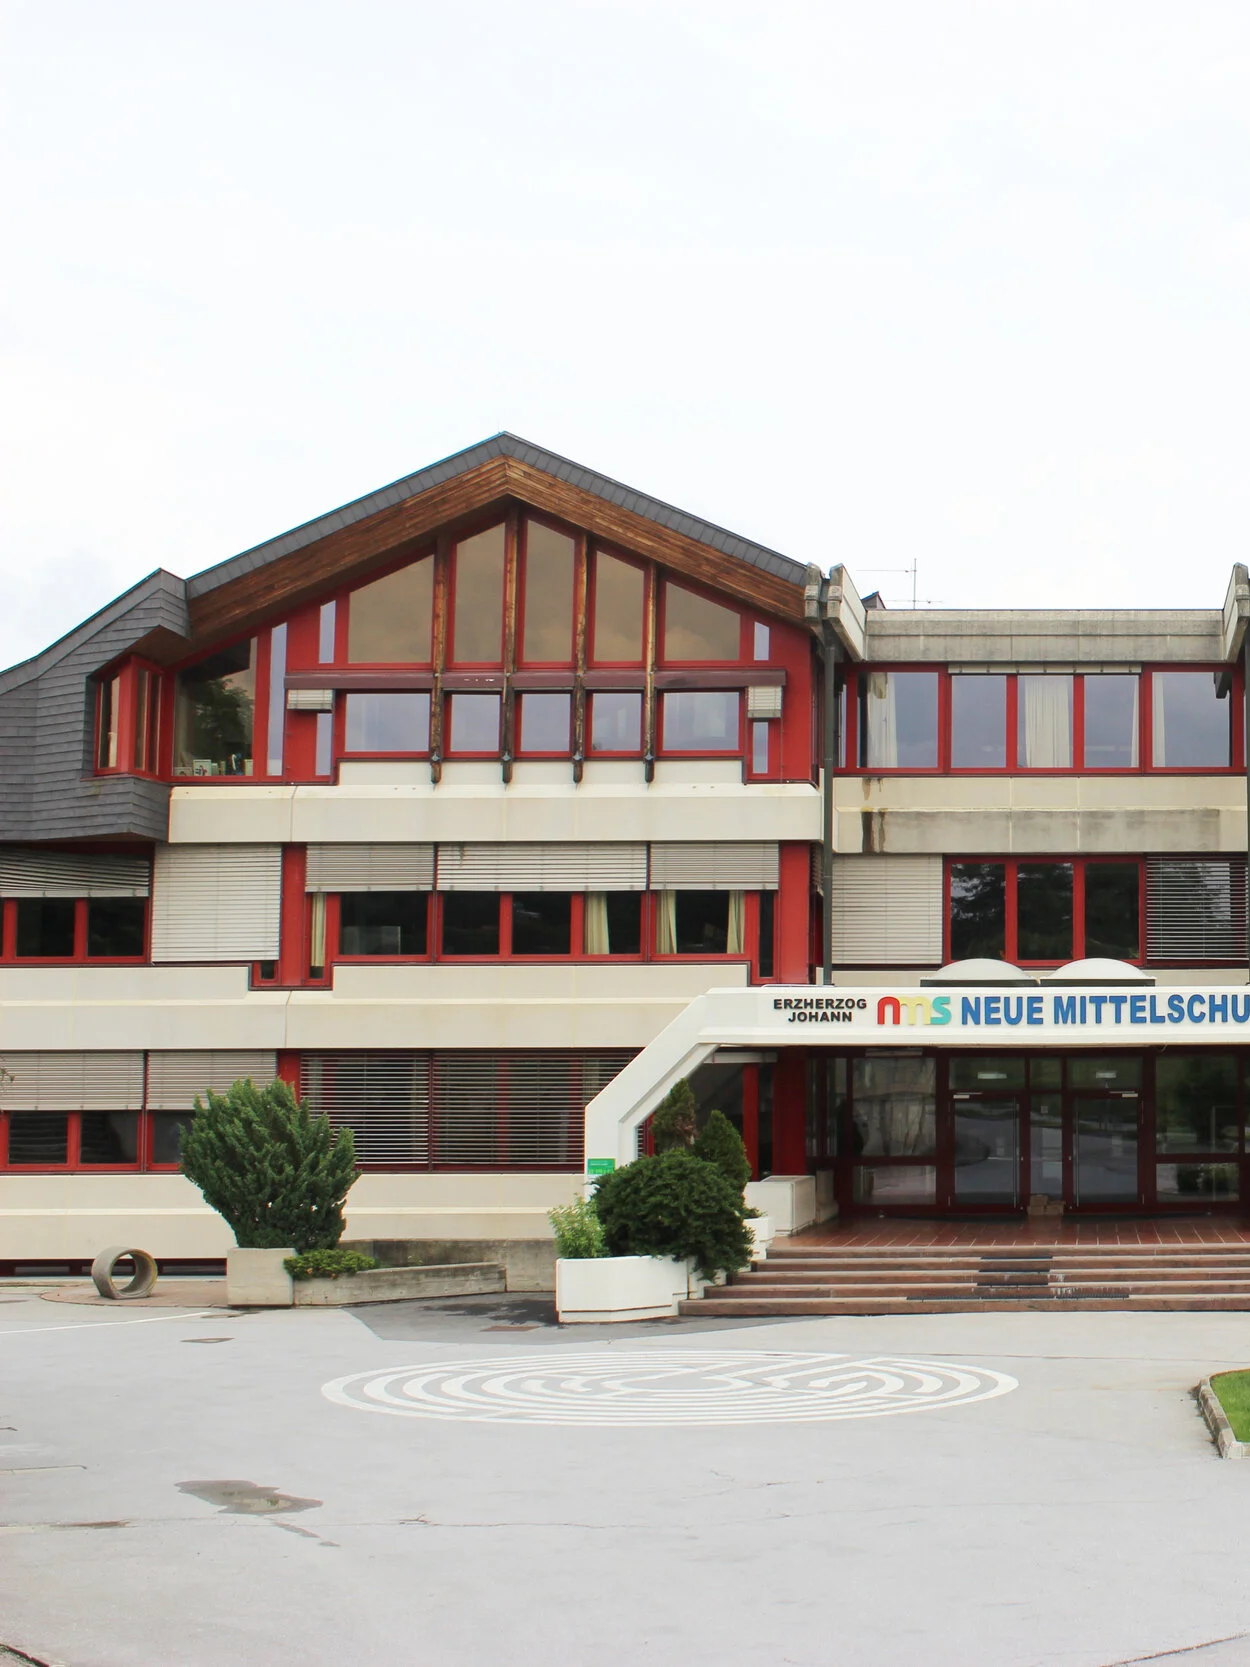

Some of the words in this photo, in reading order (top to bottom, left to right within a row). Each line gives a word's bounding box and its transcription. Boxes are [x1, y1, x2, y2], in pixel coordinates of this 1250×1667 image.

[773, 998, 867, 1010] ERZHERZOG
[877, 996, 953, 1025] nms
[961, 996, 1044, 1025] NEUE
[788, 1011, 853, 1023] JOHANN
